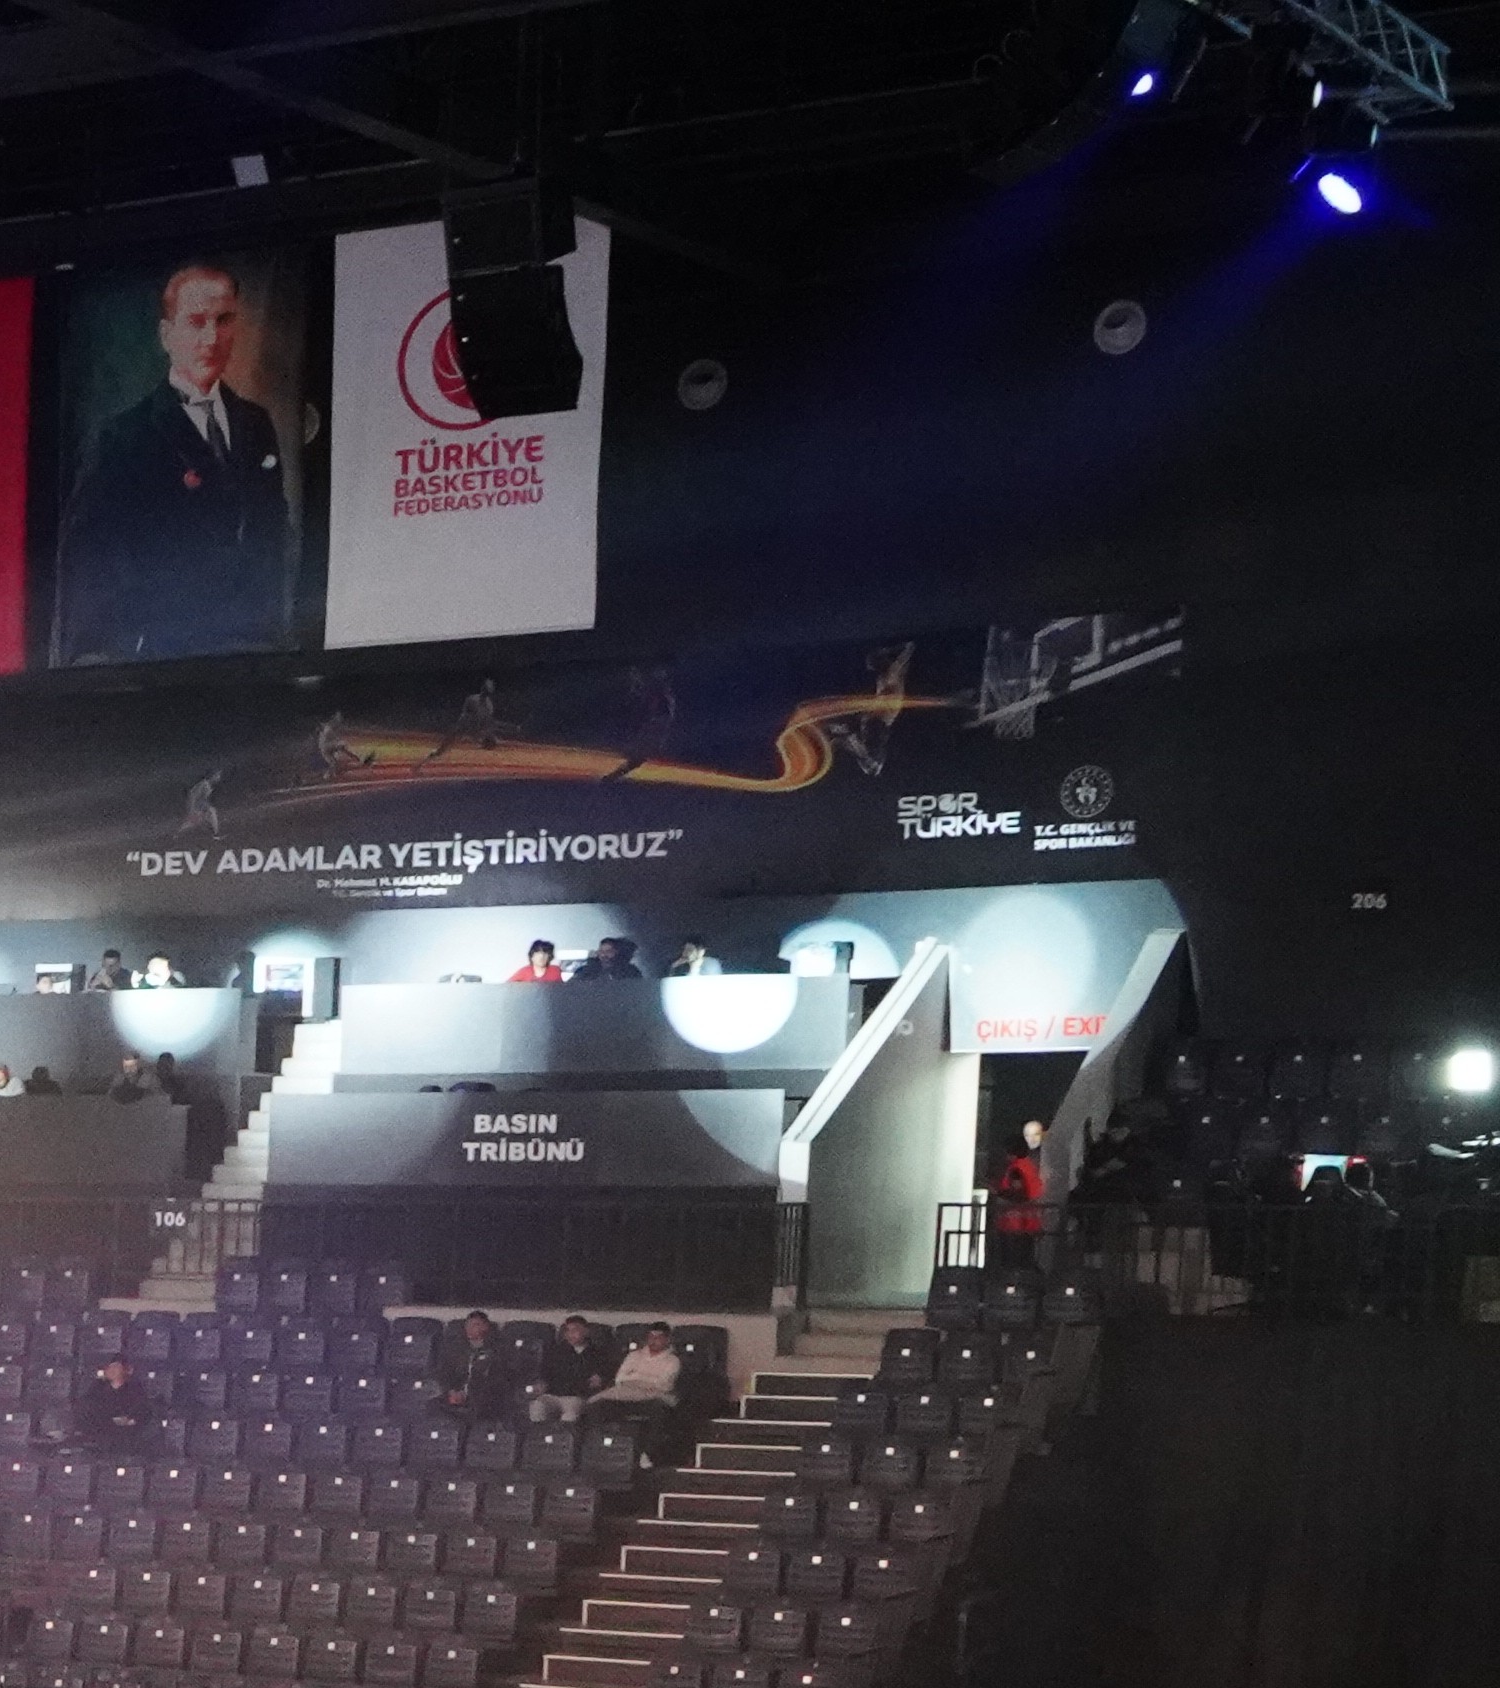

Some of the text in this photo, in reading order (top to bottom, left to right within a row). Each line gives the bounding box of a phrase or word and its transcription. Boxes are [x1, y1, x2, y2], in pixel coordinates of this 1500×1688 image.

[395, 432, 545, 475] TÜRKİYE
[394, 465, 544, 498] BASKETBOL
[393, 487, 544, 517] FEDERASYONU
[897, 808, 1022, 841] TÜRKİYE
[216, 842, 382, 875] ADAMLAR
[976, 1019, 1038, 1043] ÇIKIŞ
[473, 1113, 558, 1135] BASIN
[462, 1136, 585, 1163] TRİBÜNÜ
[154, 1211, 187, 1229] 106
